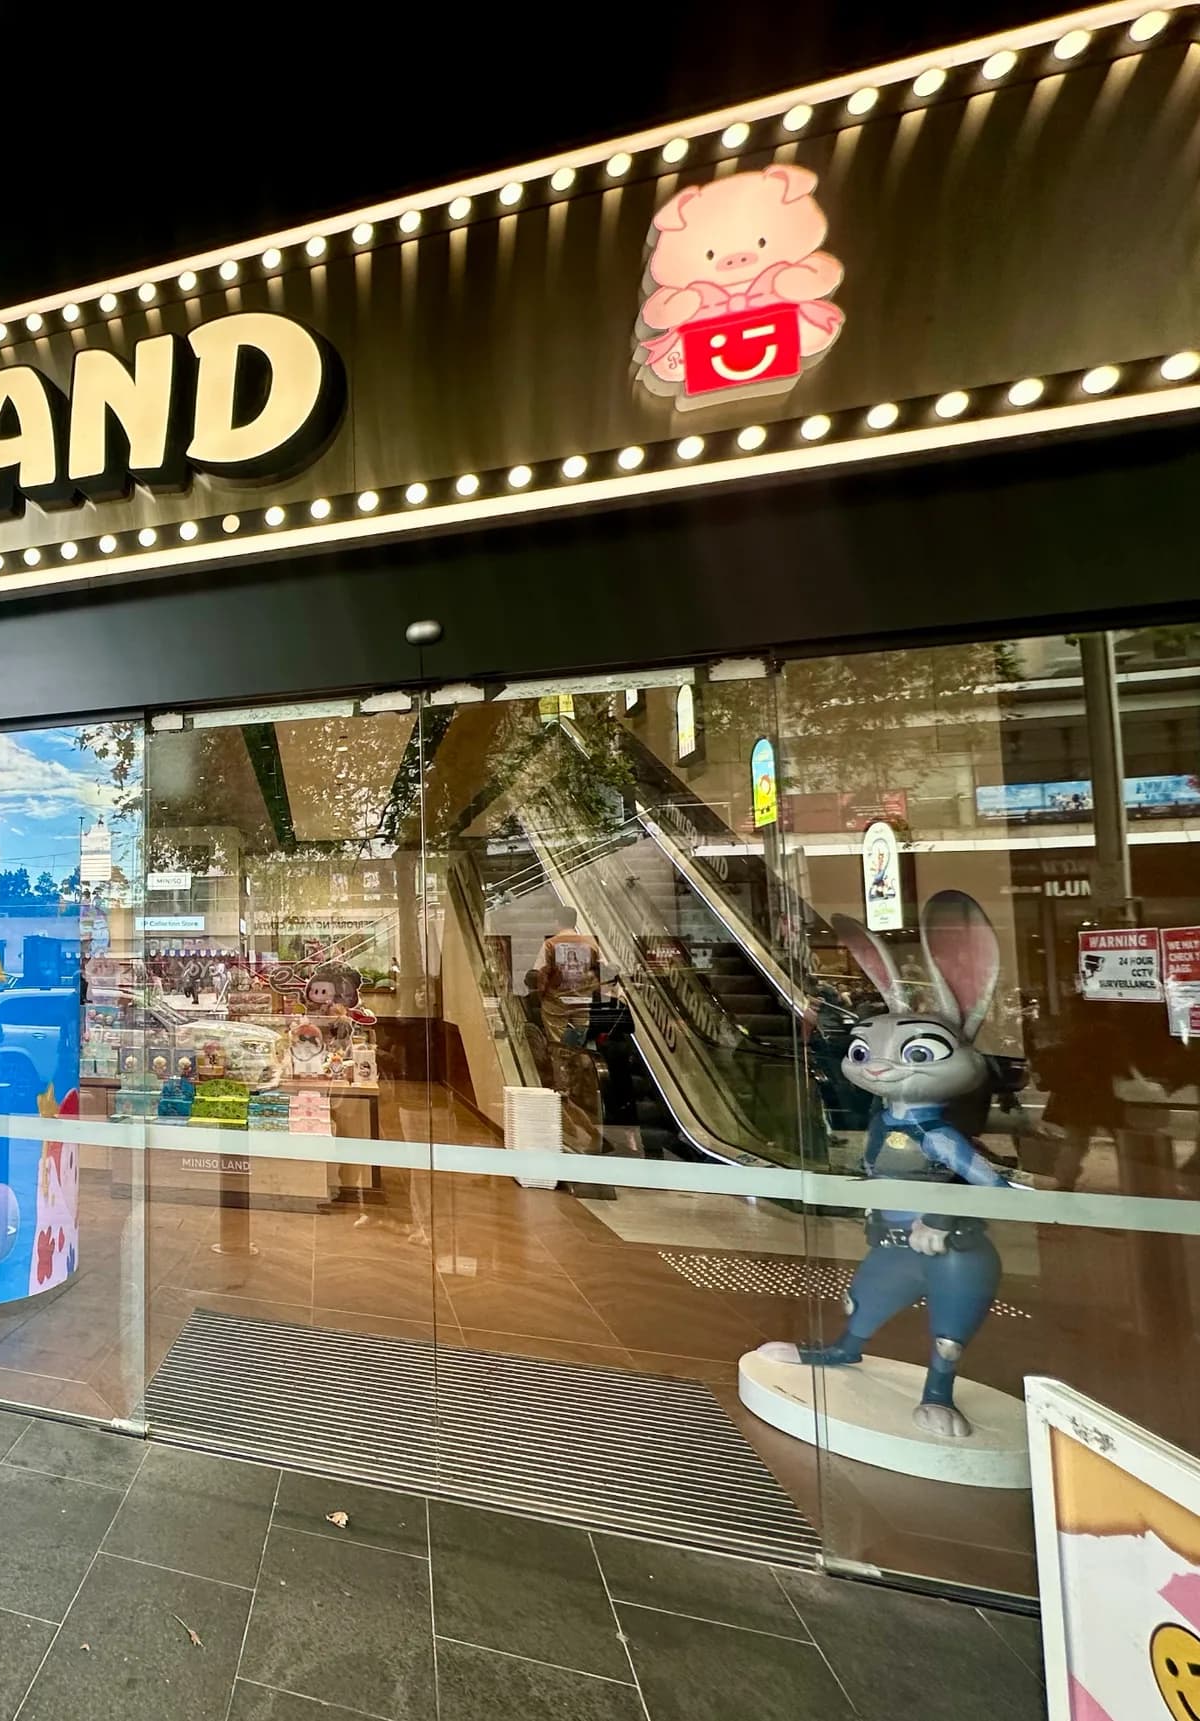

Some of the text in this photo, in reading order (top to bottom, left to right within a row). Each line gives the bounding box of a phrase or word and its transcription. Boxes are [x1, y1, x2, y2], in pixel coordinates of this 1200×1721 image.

[1088, 933, 1148, 949] WARNING
[1118, 956, 1154, 966] 24 HOUR
[1131, 968, 1154, 977] CCTV
[1099, 980, 1157, 989] SURVEILLANCE
[181, 1158, 250, 1171] MINISO LAND
